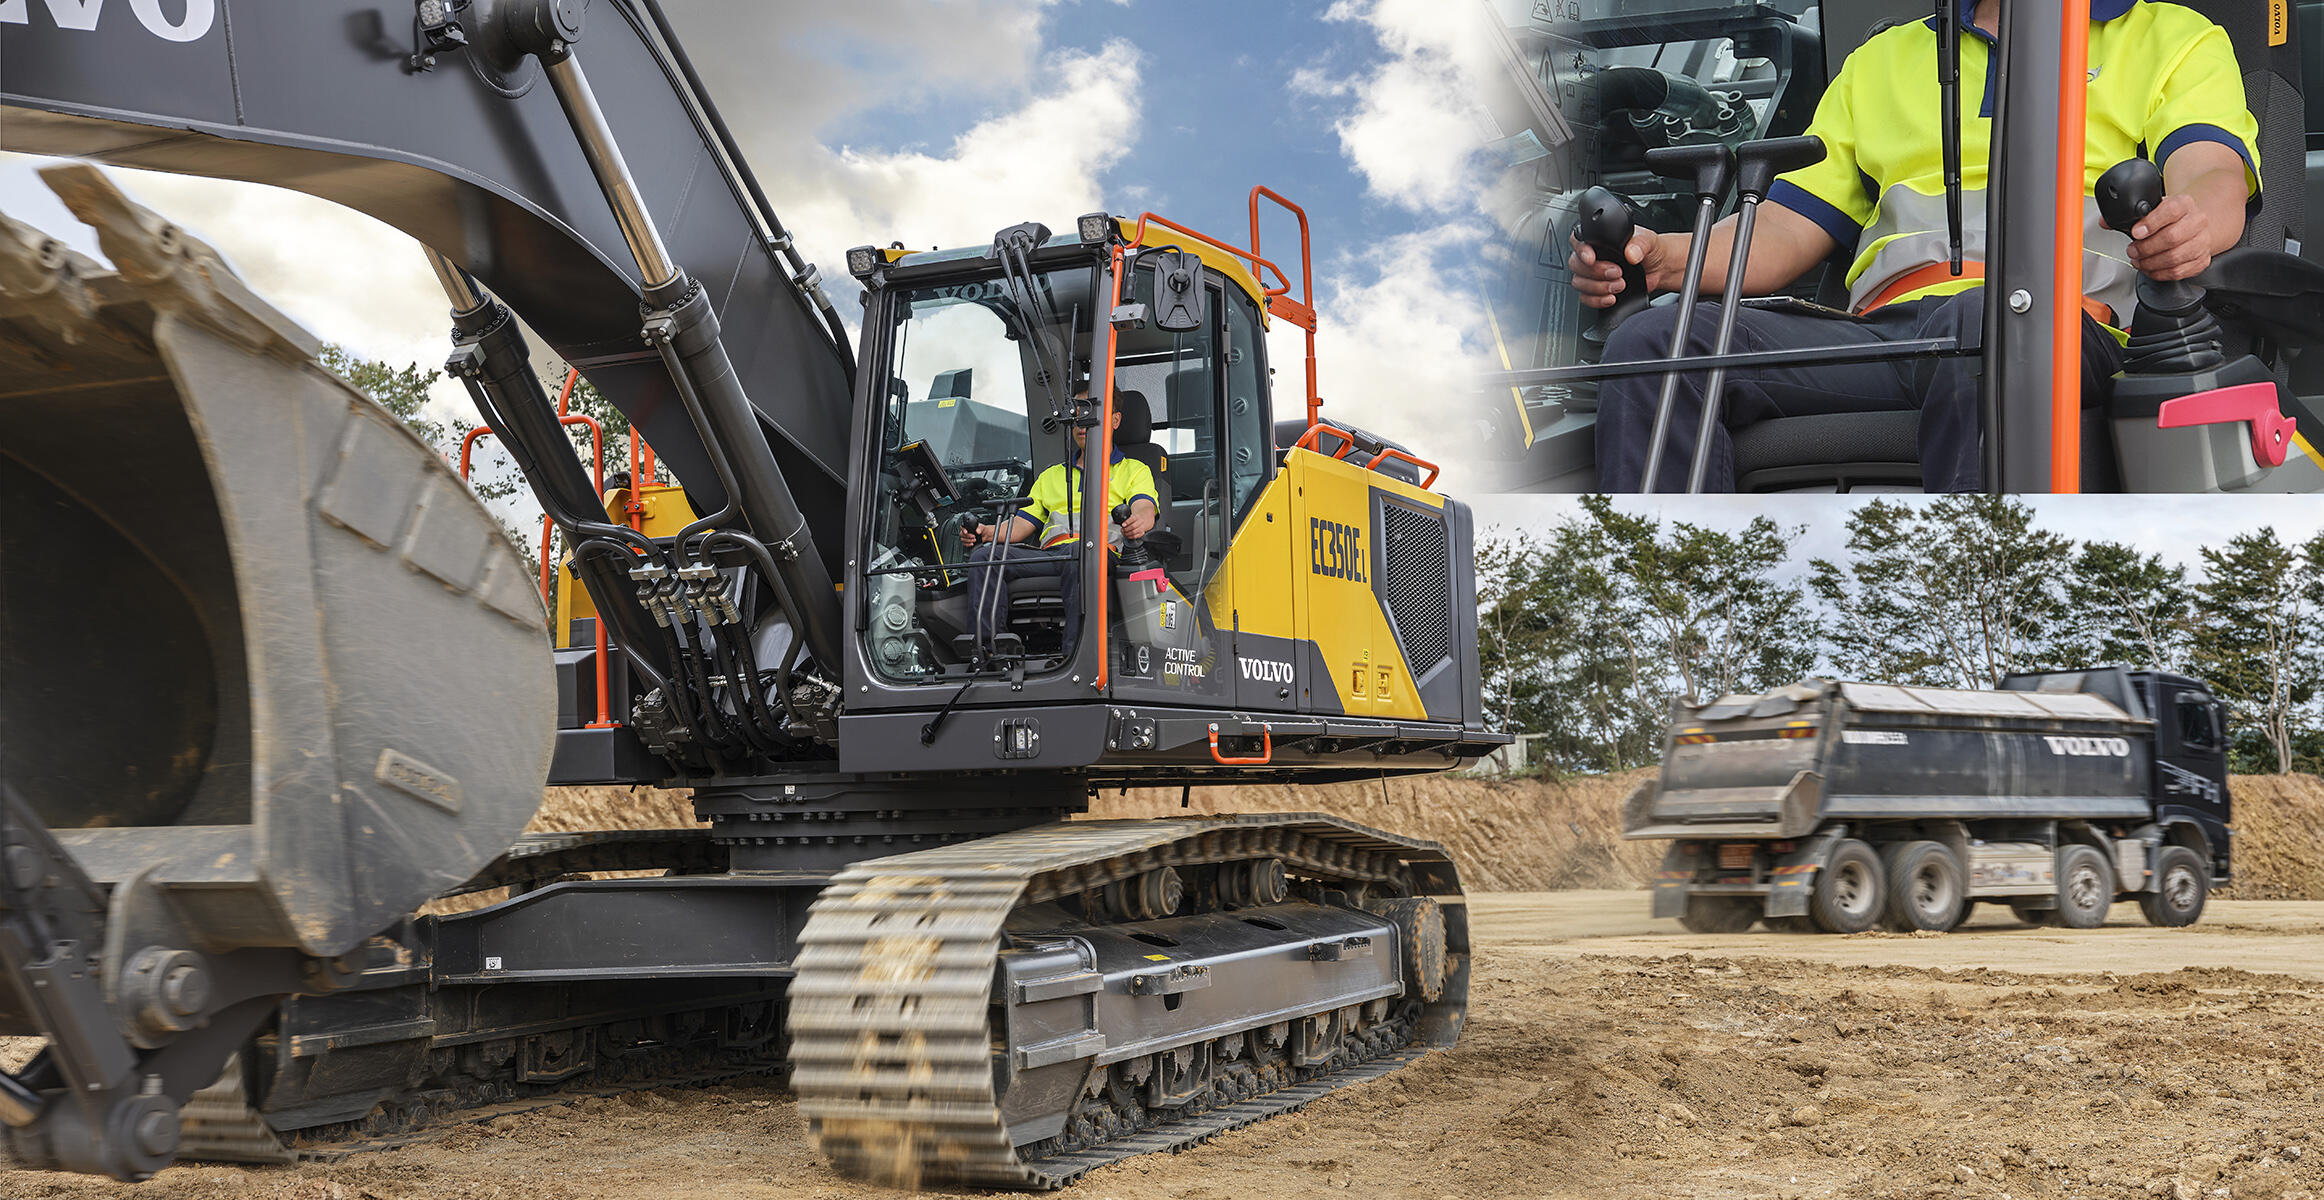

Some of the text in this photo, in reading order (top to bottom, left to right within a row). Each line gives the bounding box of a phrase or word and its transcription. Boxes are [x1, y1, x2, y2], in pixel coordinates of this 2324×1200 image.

[1165, 648, 1196, 663] ACTIVE
[1164, 661, 1205, 678] CONTROL
[1239, 657, 1294, 684] VOLVO
[2043, 736, 2130, 757] VOLVO
